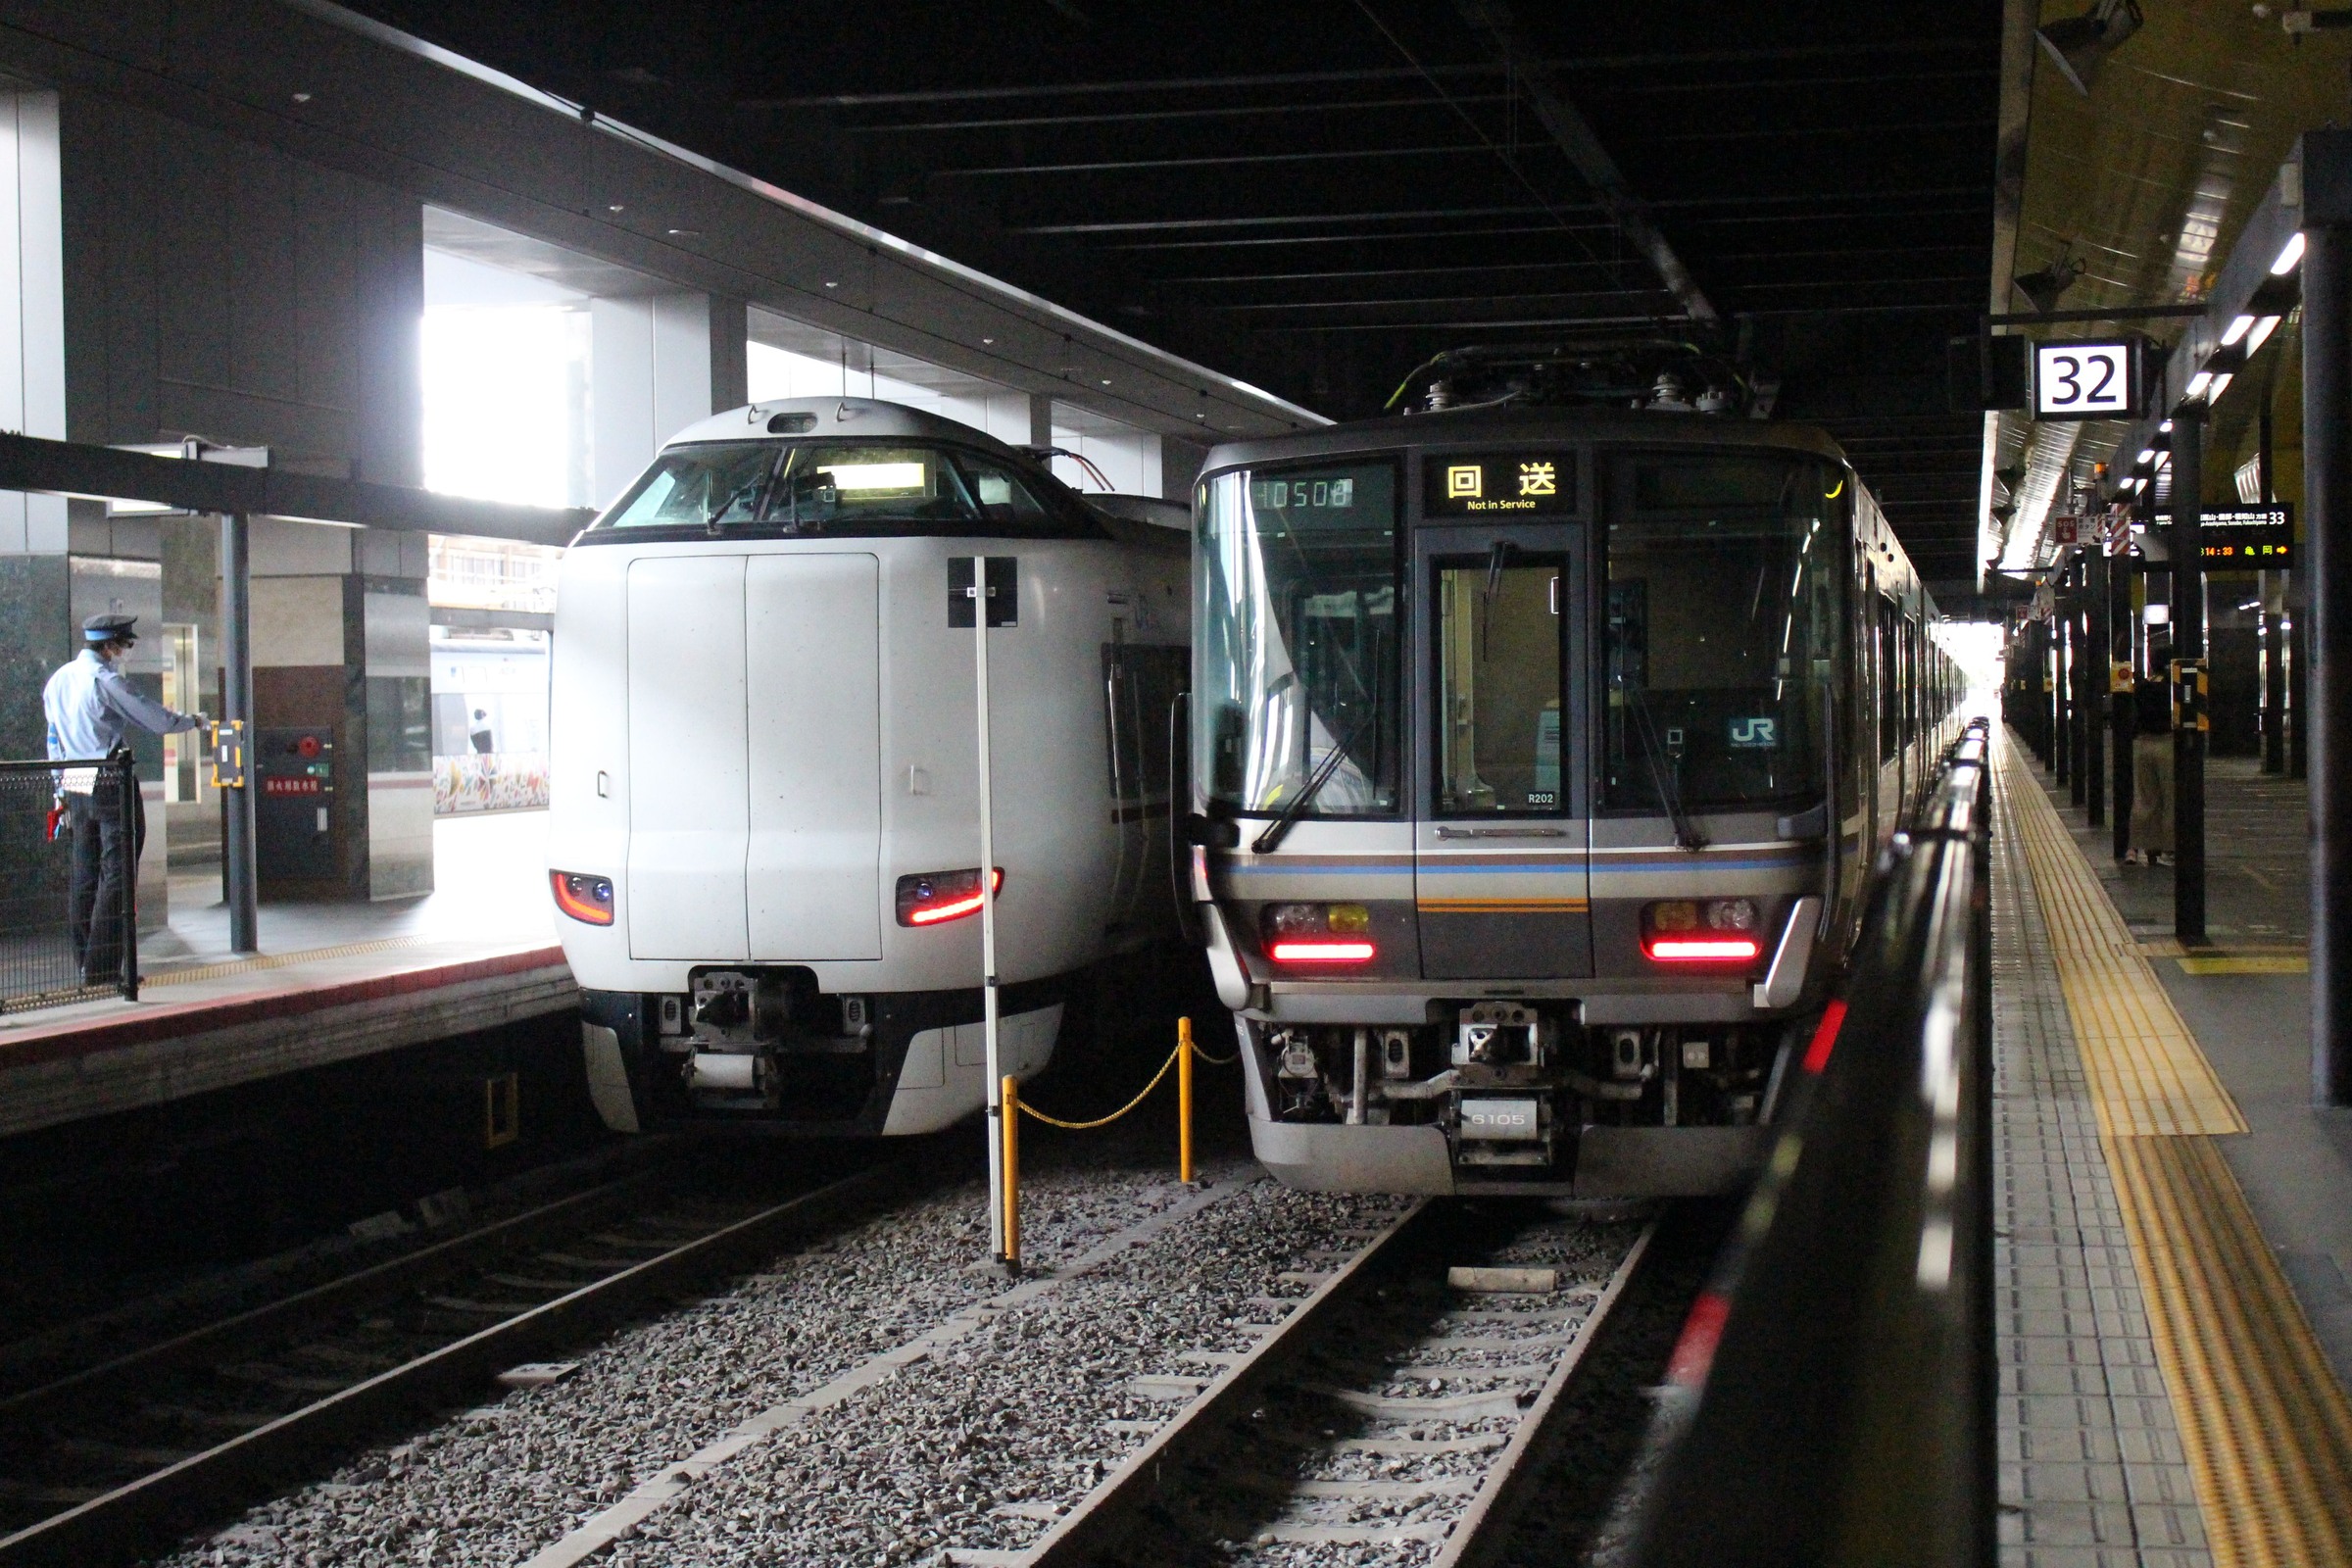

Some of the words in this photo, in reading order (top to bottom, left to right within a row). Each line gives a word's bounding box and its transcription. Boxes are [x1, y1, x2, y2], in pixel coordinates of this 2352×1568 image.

[2052, 355, 2117, 405] 32
[1448, 462, 1556, 499] 回送
[1467, 501, 1486, 510] Not
[1488, 501, 1497, 510] in
[1499, 499, 1536, 509] Service
[2057, 519, 2076, 528] SOS
[2269, 512, 2285, 525] 33
[1733, 718, 1774, 741] JR
[1529, 794, 1553, 804] R202
[1471, 1114, 1526, 1125] 6105
